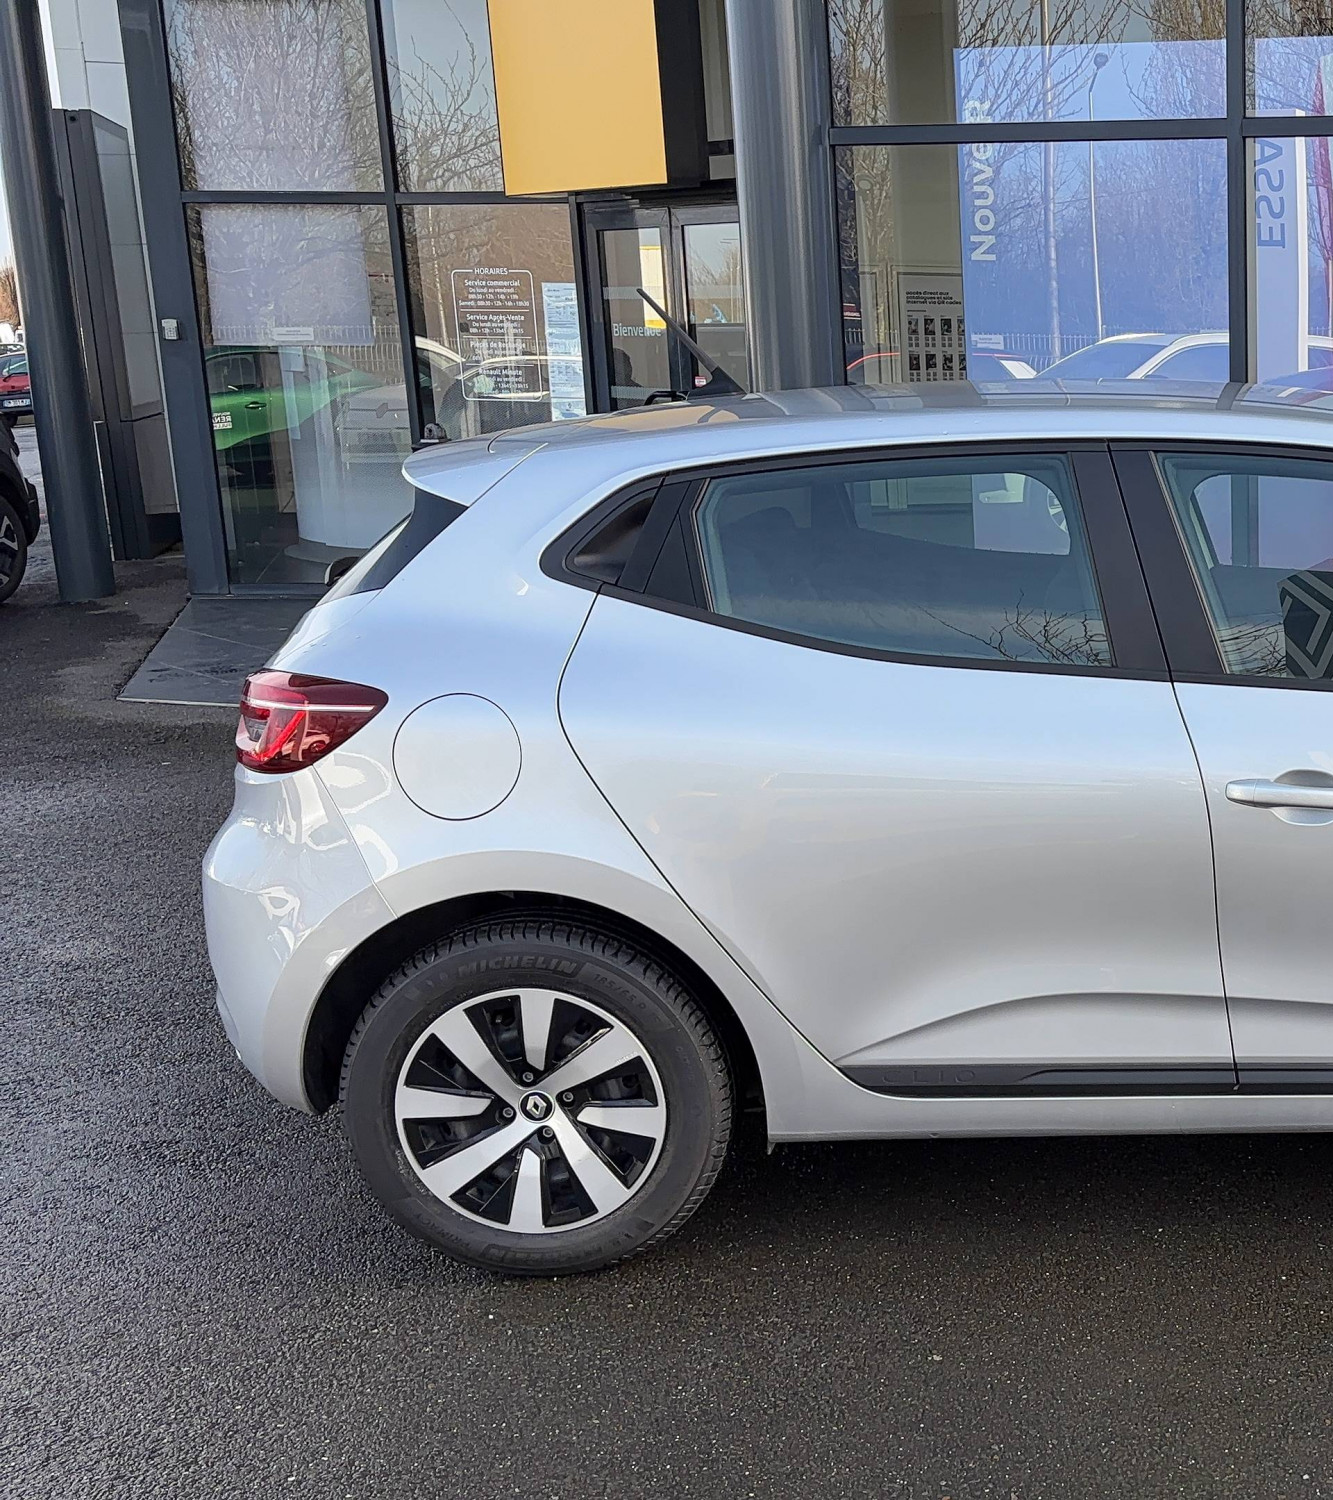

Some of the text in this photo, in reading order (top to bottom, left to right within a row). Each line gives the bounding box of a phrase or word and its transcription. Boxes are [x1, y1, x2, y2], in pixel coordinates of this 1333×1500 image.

[474, 267, 508, 275] HORAIRES
[612, 323, 662, 337] Bienvenue
[458, 956, 578, 978] MICHELIN
[881, 1070, 977, 1083] CLIO
